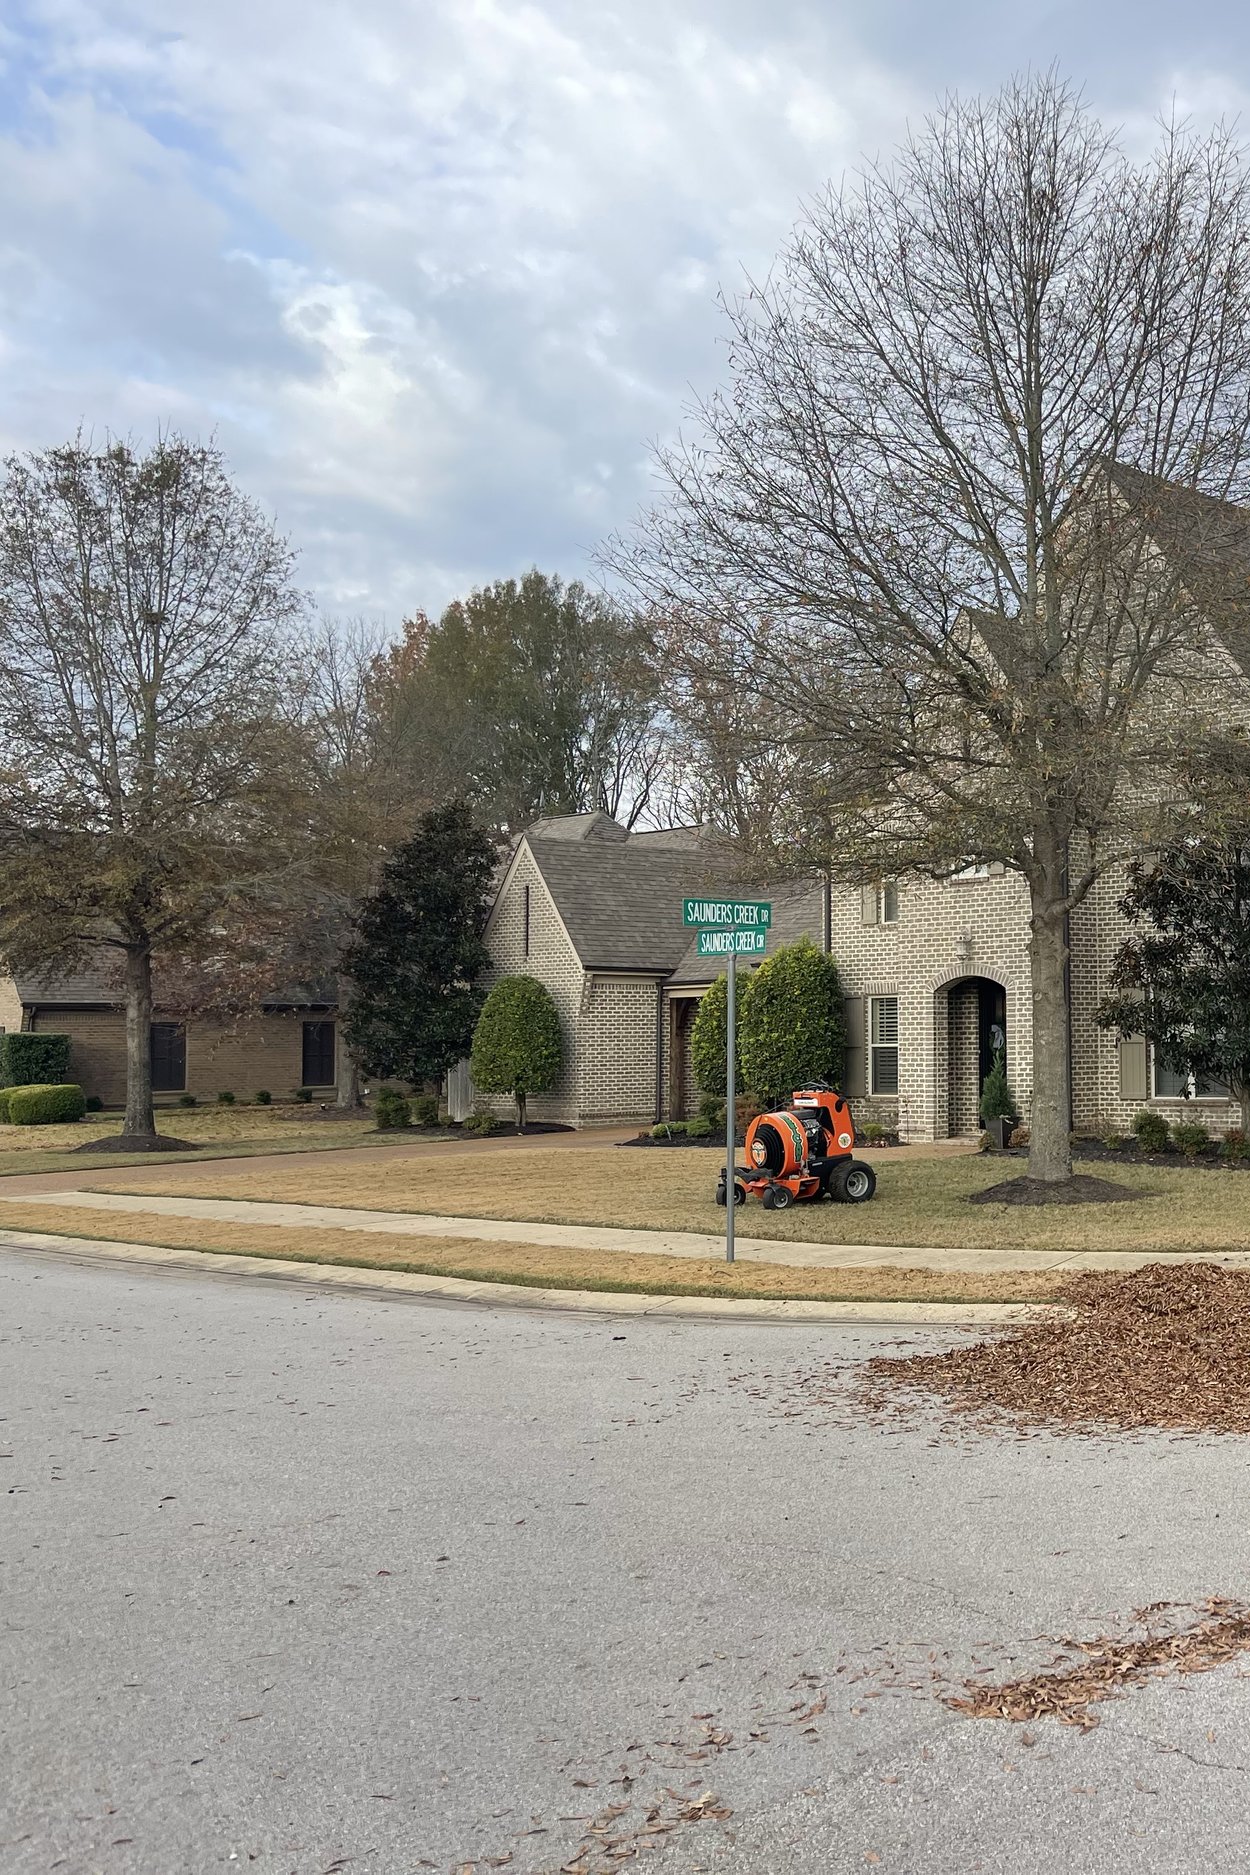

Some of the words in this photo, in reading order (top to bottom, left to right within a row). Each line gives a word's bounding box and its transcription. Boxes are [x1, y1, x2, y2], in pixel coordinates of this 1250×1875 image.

[687, 902, 732, 923] SAUNDERS
[734, 905, 758, 924] CREEK
[761, 909, 769, 923] DR
[701, 932, 734, 952] SAUNDERS
[735, 931, 756, 951] CREEK
